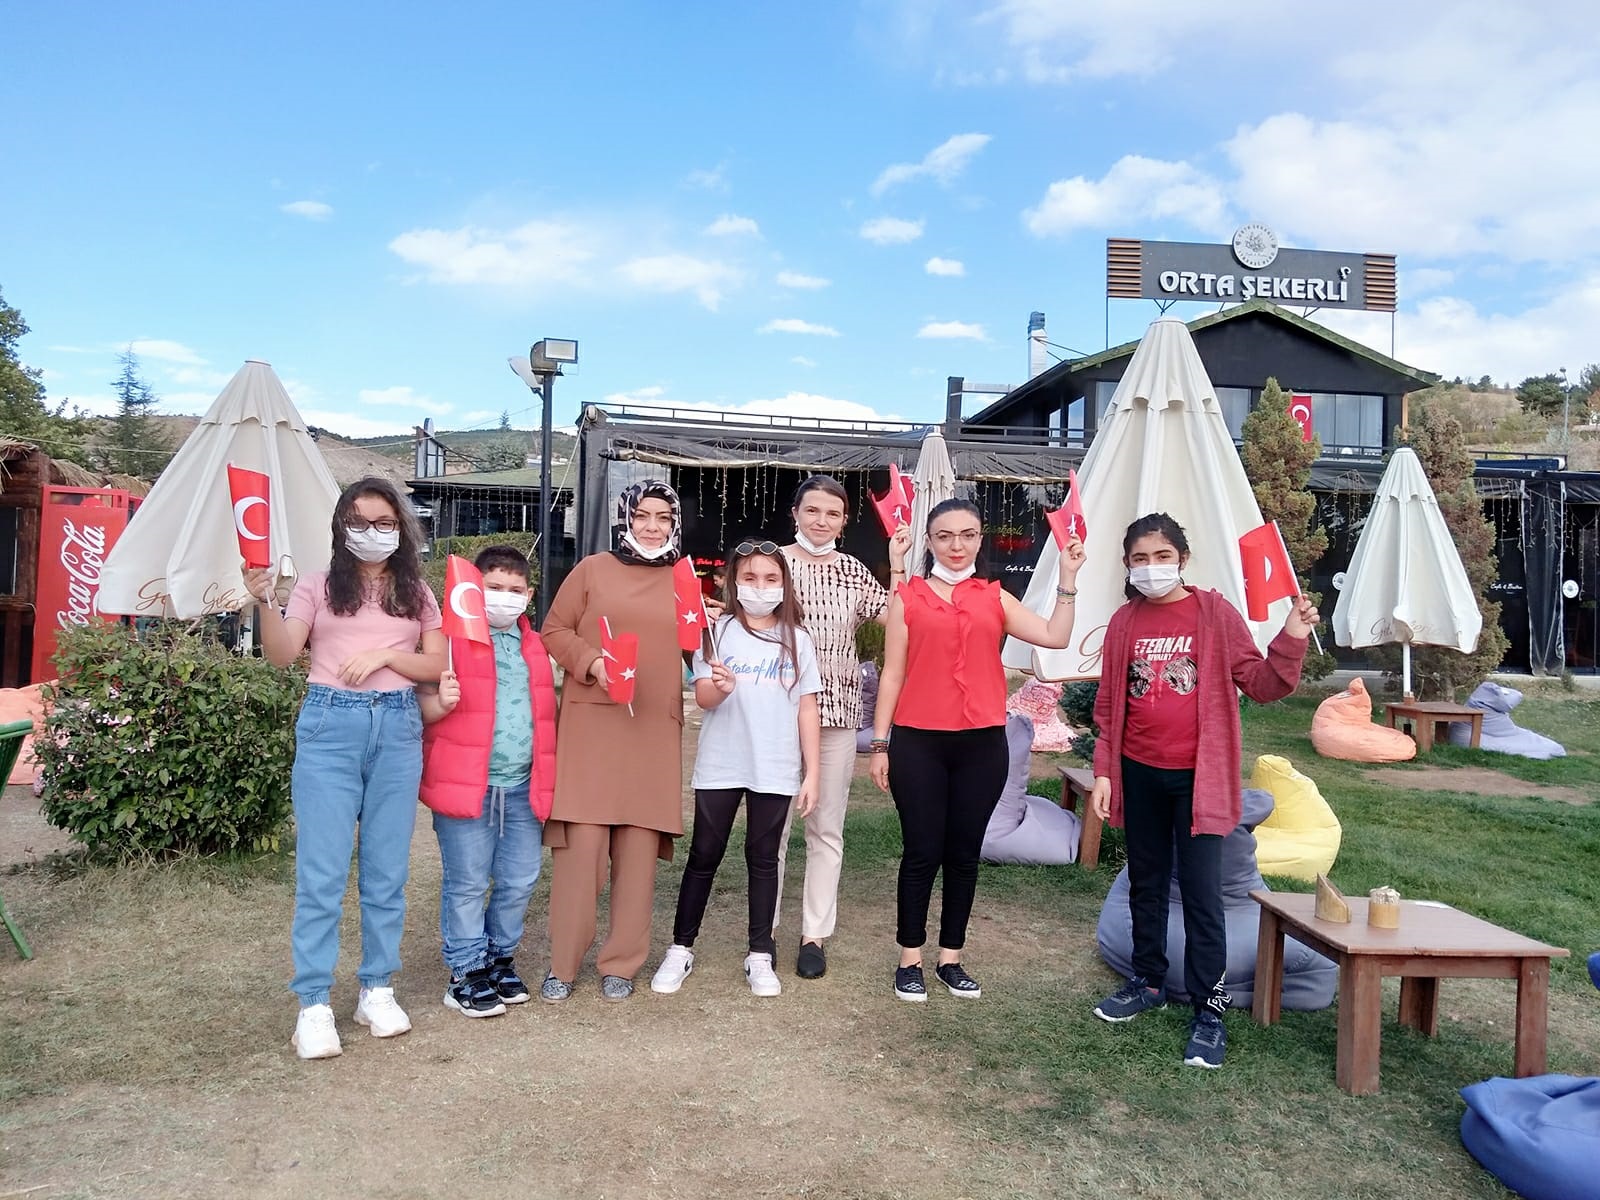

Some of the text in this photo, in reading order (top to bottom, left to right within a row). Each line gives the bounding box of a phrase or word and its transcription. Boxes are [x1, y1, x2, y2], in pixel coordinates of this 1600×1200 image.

[1159, 267, 1351, 301] ORTA ŞEKERLİ
[57, 517, 106, 634] Coca-Cola
[753, 659, 766, 686] of
